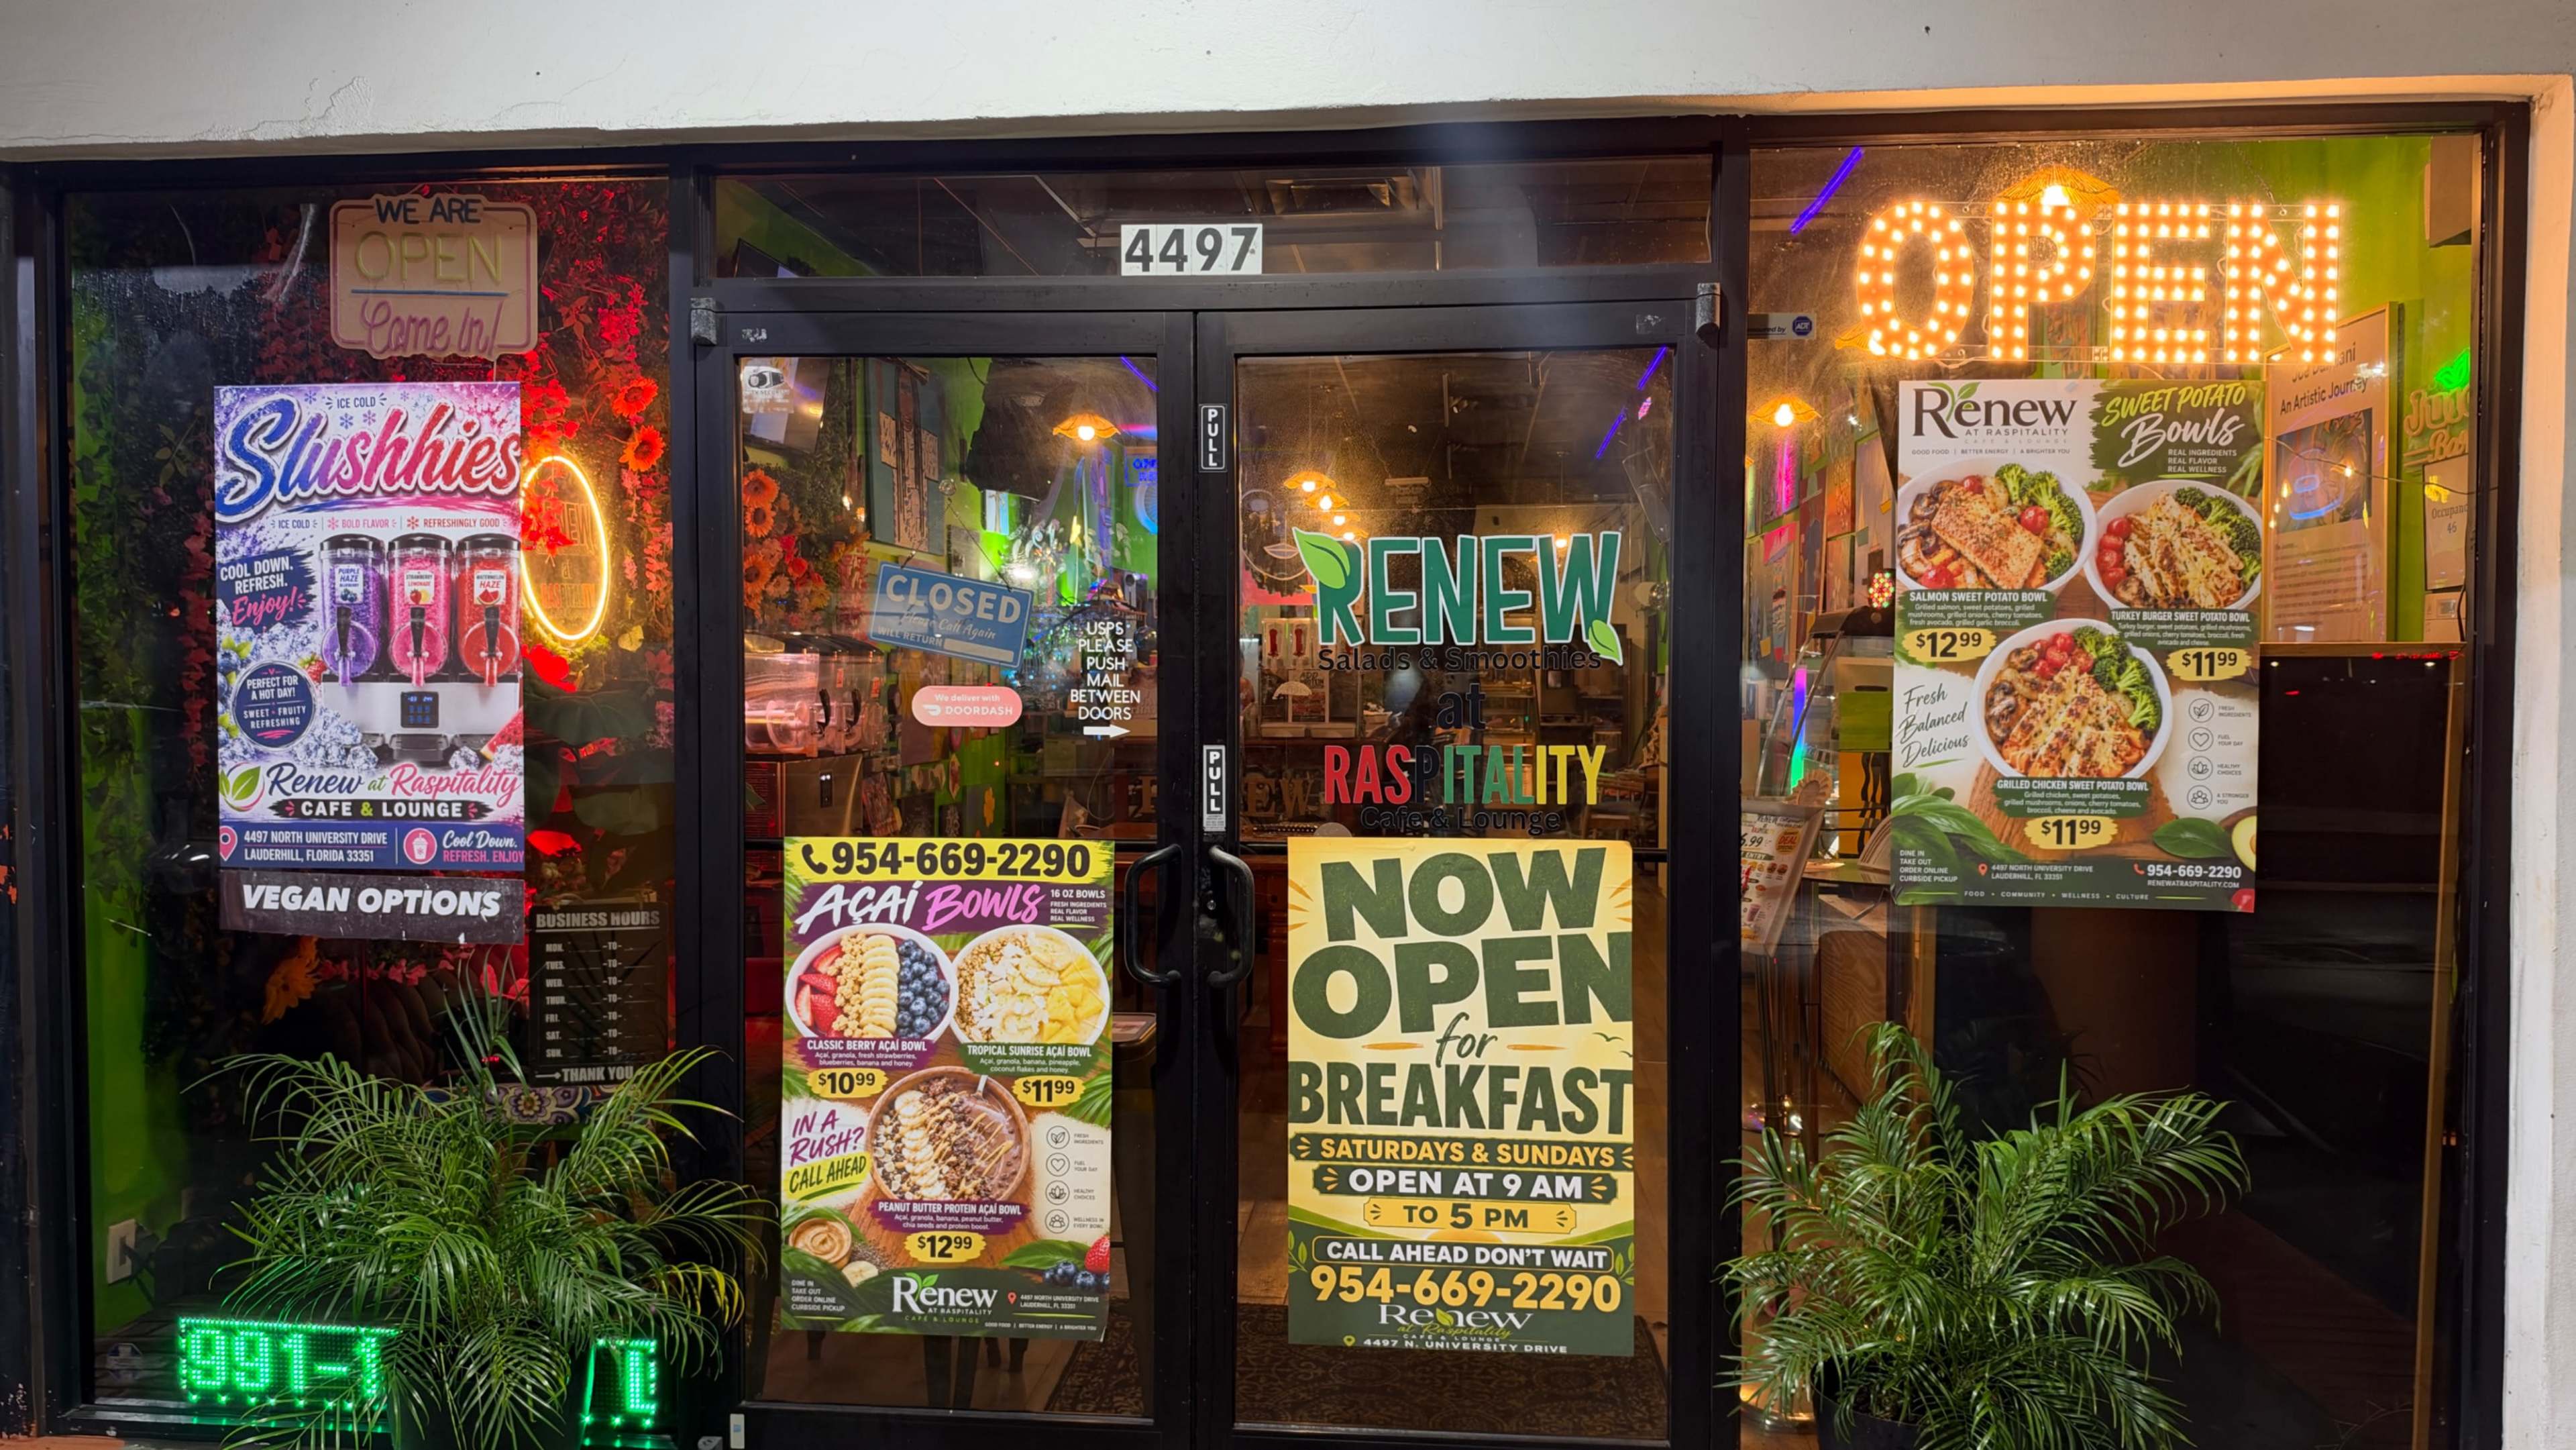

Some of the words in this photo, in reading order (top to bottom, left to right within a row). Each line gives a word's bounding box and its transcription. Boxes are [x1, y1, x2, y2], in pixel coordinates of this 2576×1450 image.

[375, 199, 419, 224] WE
[430, 199, 481, 224] ARE
[356, 231, 501, 285] OPEN
[1125, 227, 1258, 272] 4497
[1856, 200, 2340, 362] OPEN
[361, 299, 451, 354] Come
[337, 398, 350, 409] ICE
[354, 397, 376, 408] COLD
[1913, 388, 2078, 439] Renew
[2101, 387, 2179, 427] SWEET
[2177, 382, 2246, 413] POTATO
[2280, 399, 2292, 415] An
[2294, 386, 2326, 413] Artistic
[1207, 407, 1218, 466] PULL
[2117, 407, 2246, 468] Bowls
[215, 394, 521, 521] Slushhies
[278, 519, 290, 529] ICE
[291, 519, 310, 529] COLD
[342, 518, 362, 528] BOLD
[364, 518, 389, 528] FLAVOR
[423, 517, 474, 527] REFRESHINGLY
[478, 517, 500, 527] GOOD
[220, 562, 250, 581] COOL
[254, 556, 293, 576] DOWN.
[235, 573, 288, 594] REFRESH.
[1316, 531, 1621, 646] RENEW
[232, 586, 298, 626] Enjoy!
[886, 574, 1021, 623] CLOSED
[1910, 592, 1949, 602] SALMON
[1951, 592, 1982, 602] SWEET
[1985, 592, 2019, 602] POTATO
[2021, 592, 2048, 602] BOWL
[878, 626, 900, 638] WILL
[903, 631, 943, 647] RETURN
[938, 617, 963, 633] Call
[963, 623, 996, 641] Again
[1087, 621, 1124, 635] USPS
[1078, 639, 1133, 652] PLEASE
[1318, 647, 1411, 671] Salads
[1419, 649, 1438, 670] &
[1446, 645, 1602, 671] Smoothies
[1087, 657, 1125, 671] PUSH
[247, 677, 280, 689] PERFECT
[283, 675, 298, 685] FOR
[252, 691, 258, 700] A
[259, 688, 275, 699] HOT
[278, 687, 295, 697] DAY!
[1087, 674, 1124, 688] MAIL
[935, 694, 949, 702] We
[951, 694, 979, 702] deliver
[982, 694, 1000, 702] with
[1071, 689, 1140, 703] BETWEEN
[1437, 682, 1486, 730] at
[1903, 682, 1948, 714] Fresh
[244, 709, 269, 719] SWEET
[278, 706, 306, 717] FRUITY
[251, 717, 300, 729] REFRESHING
[945, 706, 1012, 715] DOORDASH
[1078, 707, 1132, 720] DOORS
[1895, 701, 1968, 744] Balanced
[1901, 735, 1970, 768] Delicious
[267, 764, 364, 796] Renew
[368, 775, 386, 791] at
[390, 763, 521, 808] Raspitality
[1209, 752, 1220, 811] PULL
[1324, 745, 1607, 805] RASPITALITY
[301, 801, 352, 817] CAFE
[360, 802, 374, 817] &
[382, 802, 462, 817] LOUNGE
[1360, 807, 1421, 830] Cafe
[1430, 809, 1450, 829] &
[1457, 807, 1560, 836] Lounge
[244, 831, 268, 843] 4497
[271, 831, 303, 843] NORTH
[305, 832, 358, 844] UNIVERSITY
[361, 832, 387, 845] DRIVE
[443, 831, 473, 849] Cool
[476, 831, 518, 849] Down.
[244, 849, 304, 863] LAUDERHILL,
[307, 849, 344, 862] FLORIDA
[346, 850, 374, 862] 33351
[443, 850, 489, 863] REFRESH.
[492, 850, 523, 863] ENJOY
[832, 842, 1090, 877] 954-669-2290
[2147, 864, 2242, 878] 954-669-2290
[2147, 880, 2239, 888] RENEWATRASPITALITY.COM
[242, 884, 351, 913] VEGAN
[357, 887, 501, 918] OPTIONS
[1051, 889, 1059, 898] 16
[1063, 889, 1074, 898] OZ
[1076, 890, 1106, 898] BOWLS
[1321, 847, 1607, 942] NOW
[537, 912, 607, 927] BUSINESS
[610, 911, 660, 926] HOURS
[794, 880, 923, 934] AÇAÍ
[545, 961, 565, 970] TUES.
[545, 978, 564, 988] WED.
[1292, 931, 1633, 1039] OPEN
[545, 1014, 560, 1023] FRI.
[545, 1031, 561, 1040] SAT.
[807, 1040, 844, 1050] CLASSIC
[847, 1041, 876, 1051] BERRY
[878, 1039, 899, 1053] AÇAÍ
[901, 1041, 927, 1051] BOWL
[1436, 1012, 1497, 1068] for
[562, 1068, 604, 1082] THANK
[608, 1066, 634, 1080] YOU
[1288, 1060, 1633, 1135] BREAKFAST
[792, 1111, 817, 1138] IN
[820, 1109, 840, 1133] A
[790, 1127, 865, 1167] RUSH?
[1321, 1139, 1464, 1162] SATURDAYS
[1471, 1143, 1489, 1163] &
[1496, 1143, 1615, 1168] SUNDAYS
[790, 1165, 822, 1193] CALL
[826, 1155, 866, 1183] AHEAD
[1348, 1169, 1441, 1194] OPEN
[1453, 1172, 1493, 1195] AT
[1502, 1174, 1522, 1196] 9
[1529, 1176, 1582, 1199] AM
[1403, 1205, 1438, 1223] TO
[1450, 1203, 1473, 1229] 5
[1485, 1208, 1527, 1228] PM
[1327, 1241, 1383, 1261] CALL
[1389, 1244, 1468, 1263] AHEAD
[1551, 1249, 1607, 1268] WAIT
[892, 1276, 998, 1314] Renew
[1310, 1265, 1621, 1312] 954-669-2290
[1379, 1304, 1534, 1329] Renew
[1363, 1339, 1399, 1347] 4497
[1426, 1341, 1517, 1351] UNIVERSITY
[1524, 1344, 1567, 1354] DRIVE
